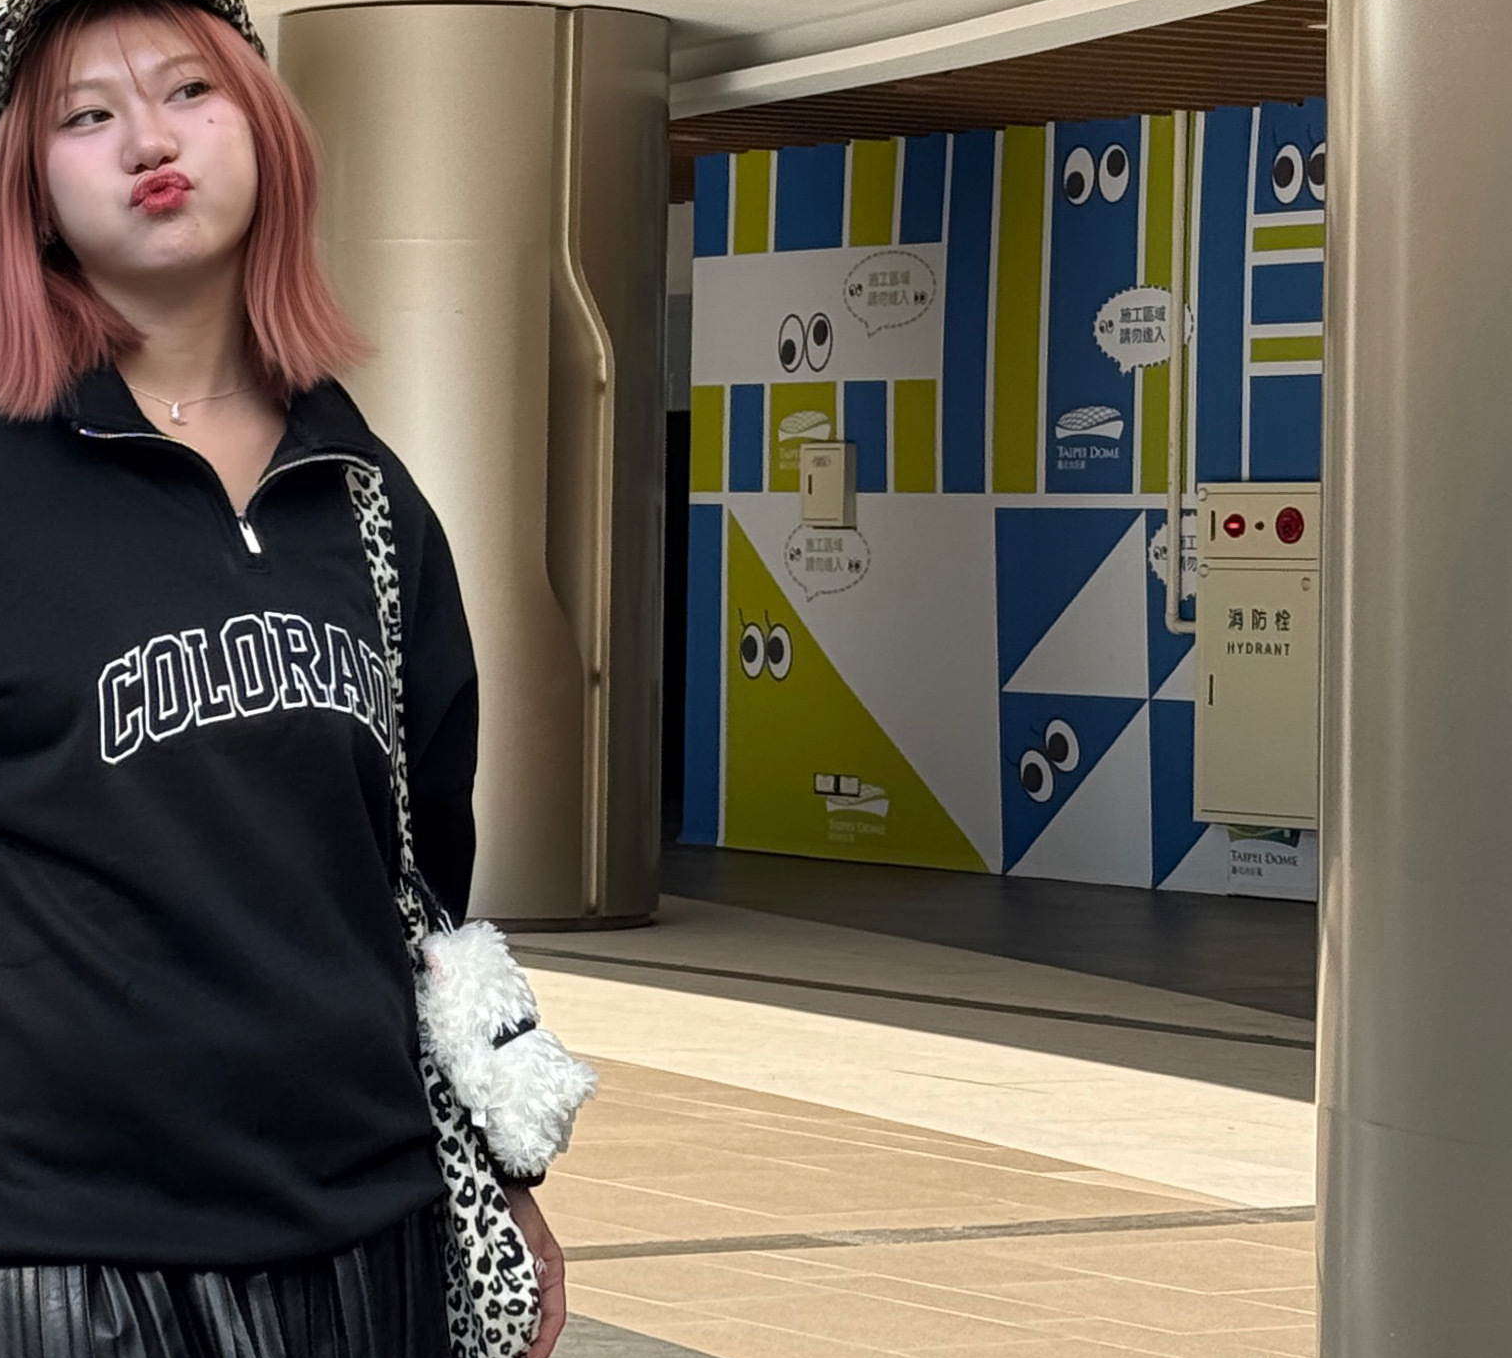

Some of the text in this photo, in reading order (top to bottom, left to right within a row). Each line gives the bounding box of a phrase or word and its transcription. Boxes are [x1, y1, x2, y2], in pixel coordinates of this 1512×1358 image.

[1228, 608, 1291, 631] 消防栓
[1227, 641, 1290, 656] HYDRANT
